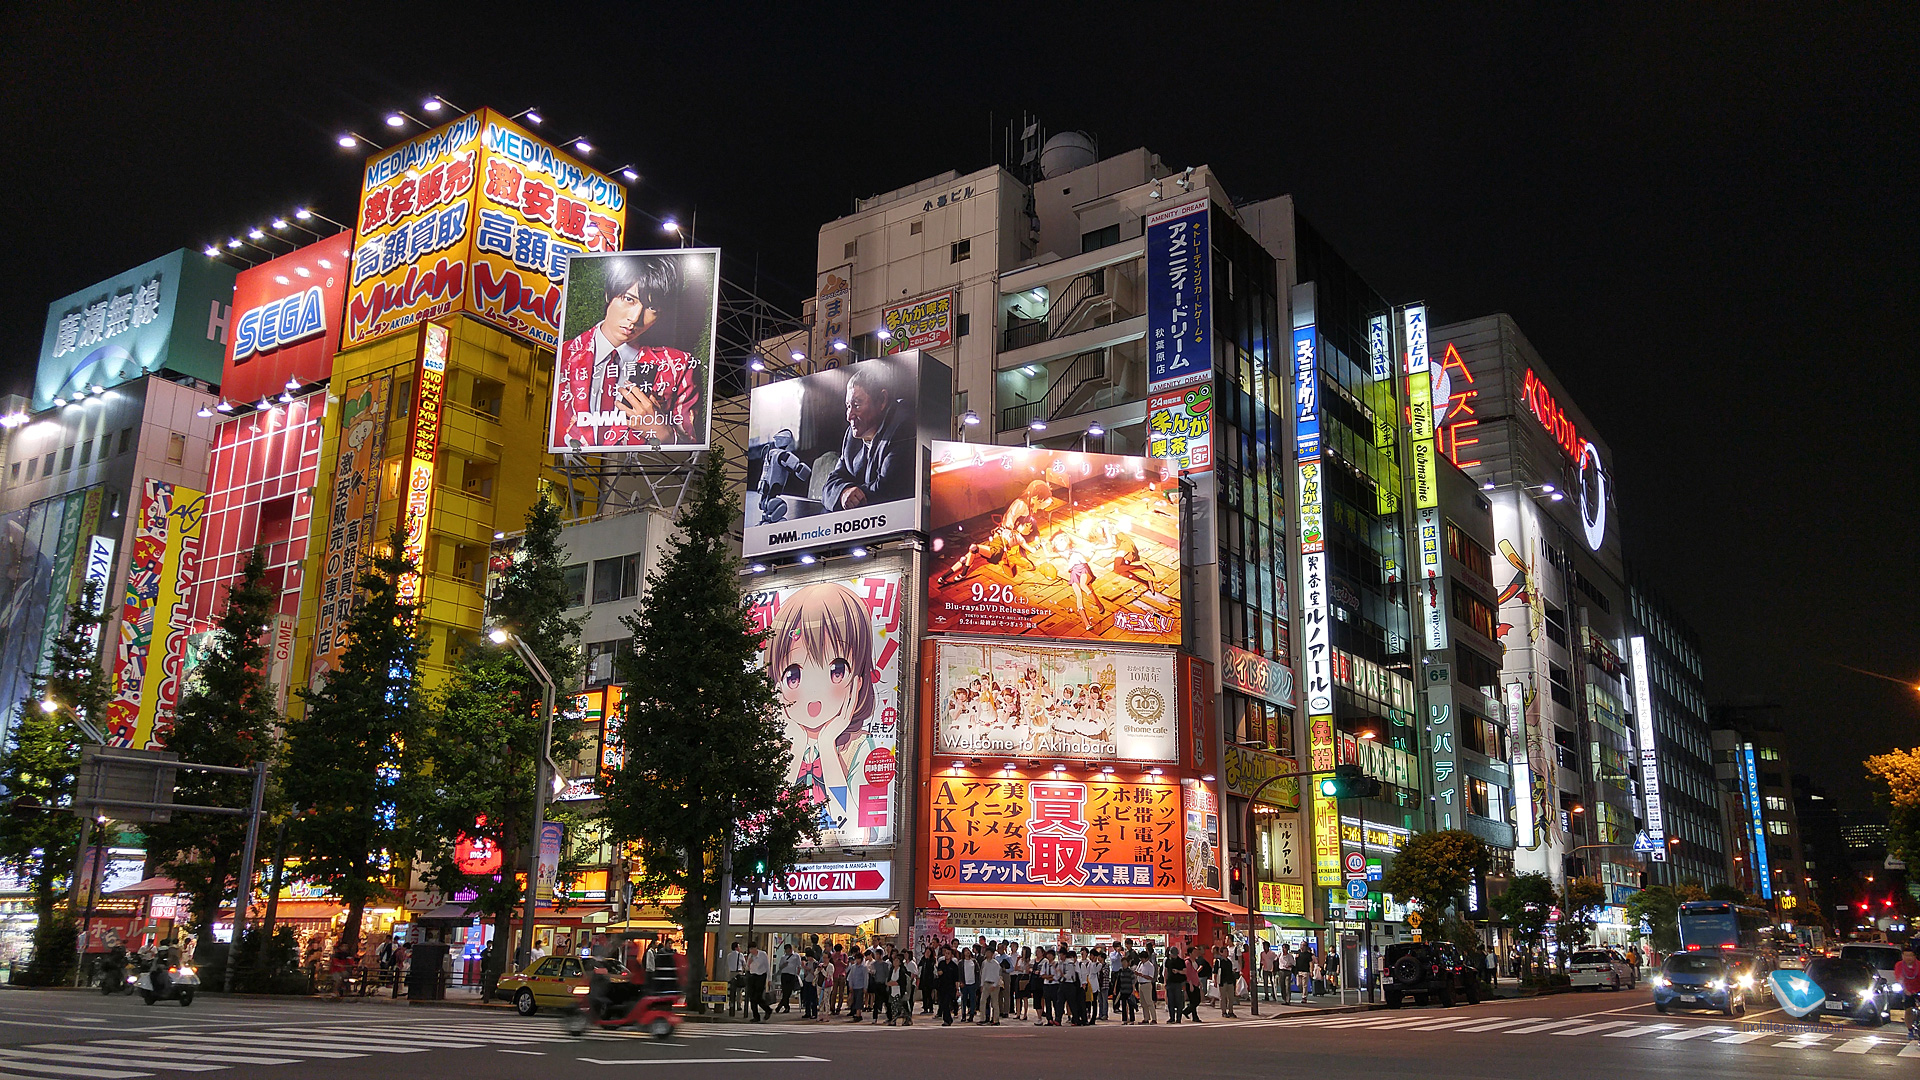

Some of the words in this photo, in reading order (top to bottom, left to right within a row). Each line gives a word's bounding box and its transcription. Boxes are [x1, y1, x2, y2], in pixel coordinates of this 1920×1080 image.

[366, 114, 480, 191] MEDIAリサイクル
[488, 121, 624, 212] MEDIAリサイクル
[361, 150, 476, 236] 激安販売
[483, 156, 620, 253] 激安販売
[1150, 209, 1179, 223] AMENITY
[1181, 202, 1205, 214] DREAM
[352, 198, 469, 287] 高額買取
[350, 258, 464, 342] Mulan
[1168, 221, 1190, 370] アメニティードリーム
[233, 286, 326, 361] SEGA
[356, 323, 390, 342] ムーラン
[390, 314, 414, 331] AKIBA
[485, 305, 529, 332] ムーラン
[885, 298, 950, 330] まんが喫茶
[1155, 328, 1166, 375] 秋葉原店
[424, 371, 442, 383] DVD
[560, 356, 709, 385] よほど自信があるか、
[1153, 379, 1181, 392] AMENITY
[1184, 373, 1209, 385] DREAM
[422, 401, 435, 411] CD
[576, 410, 627, 428] DMM
[627, 411, 684, 427] mobile
[1413, 402, 1426, 436] Yellow
[417, 419, 437, 431] アニメ
[603, 427, 658, 442] のスマホ
[1150, 410, 1209, 437] まんが
[1152, 436, 1188, 458] 喫茶
[1302, 463, 1318, 504] まんが
[1416, 444, 1430, 502] Submarine
[1422, 509, 1434, 518] 5F
[768, 526, 832, 546] DMM.make
[833, 514, 887, 536] ROBOTS
[317, 451, 355, 655] 激安販売の専門店
[999, 605, 1030, 615] Release
[1031, 607, 1052, 615] Start
[277, 620, 293, 661] GAME
[1307, 608, 1329, 693] ルノアール
[1130, 672, 1160, 682] 10周年
[943, 734, 1014, 751] Welcome
[1018, 738, 1033, 751] to
[1037, 739, 1116, 755] Akihabara
[1311, 719, 1334, 771] 免税
[960, 782, 981, 856] アイドル
[983, 783, 1003, 837] アニメ
[1003, 782, 1024, 860] 美少女系
[1092, 787, 1111, 862] フィギュア
[1113, 787, 1131, 841] ホビー
[1134, 787, 1154, 863] 携帯電話
[1026, 781, 1090, 887] 買取
[1156, 789, 1176, 888] アップルとか
[1282, 830, 1293, 875] ルノアール
[1350, 858, 1361, 867] 40
[832, 873, 856, 890] ZIN
[961, 863, 1025, 883] チケット
[1092, 865, 1152, 885] 大黒屋
[153, 897, 177, 907] GAME
[410, 894, 443, 907] ラーメン
[1351, 884, 1359, 897] P
[1015, 912, 1055, 920] WESTERN
